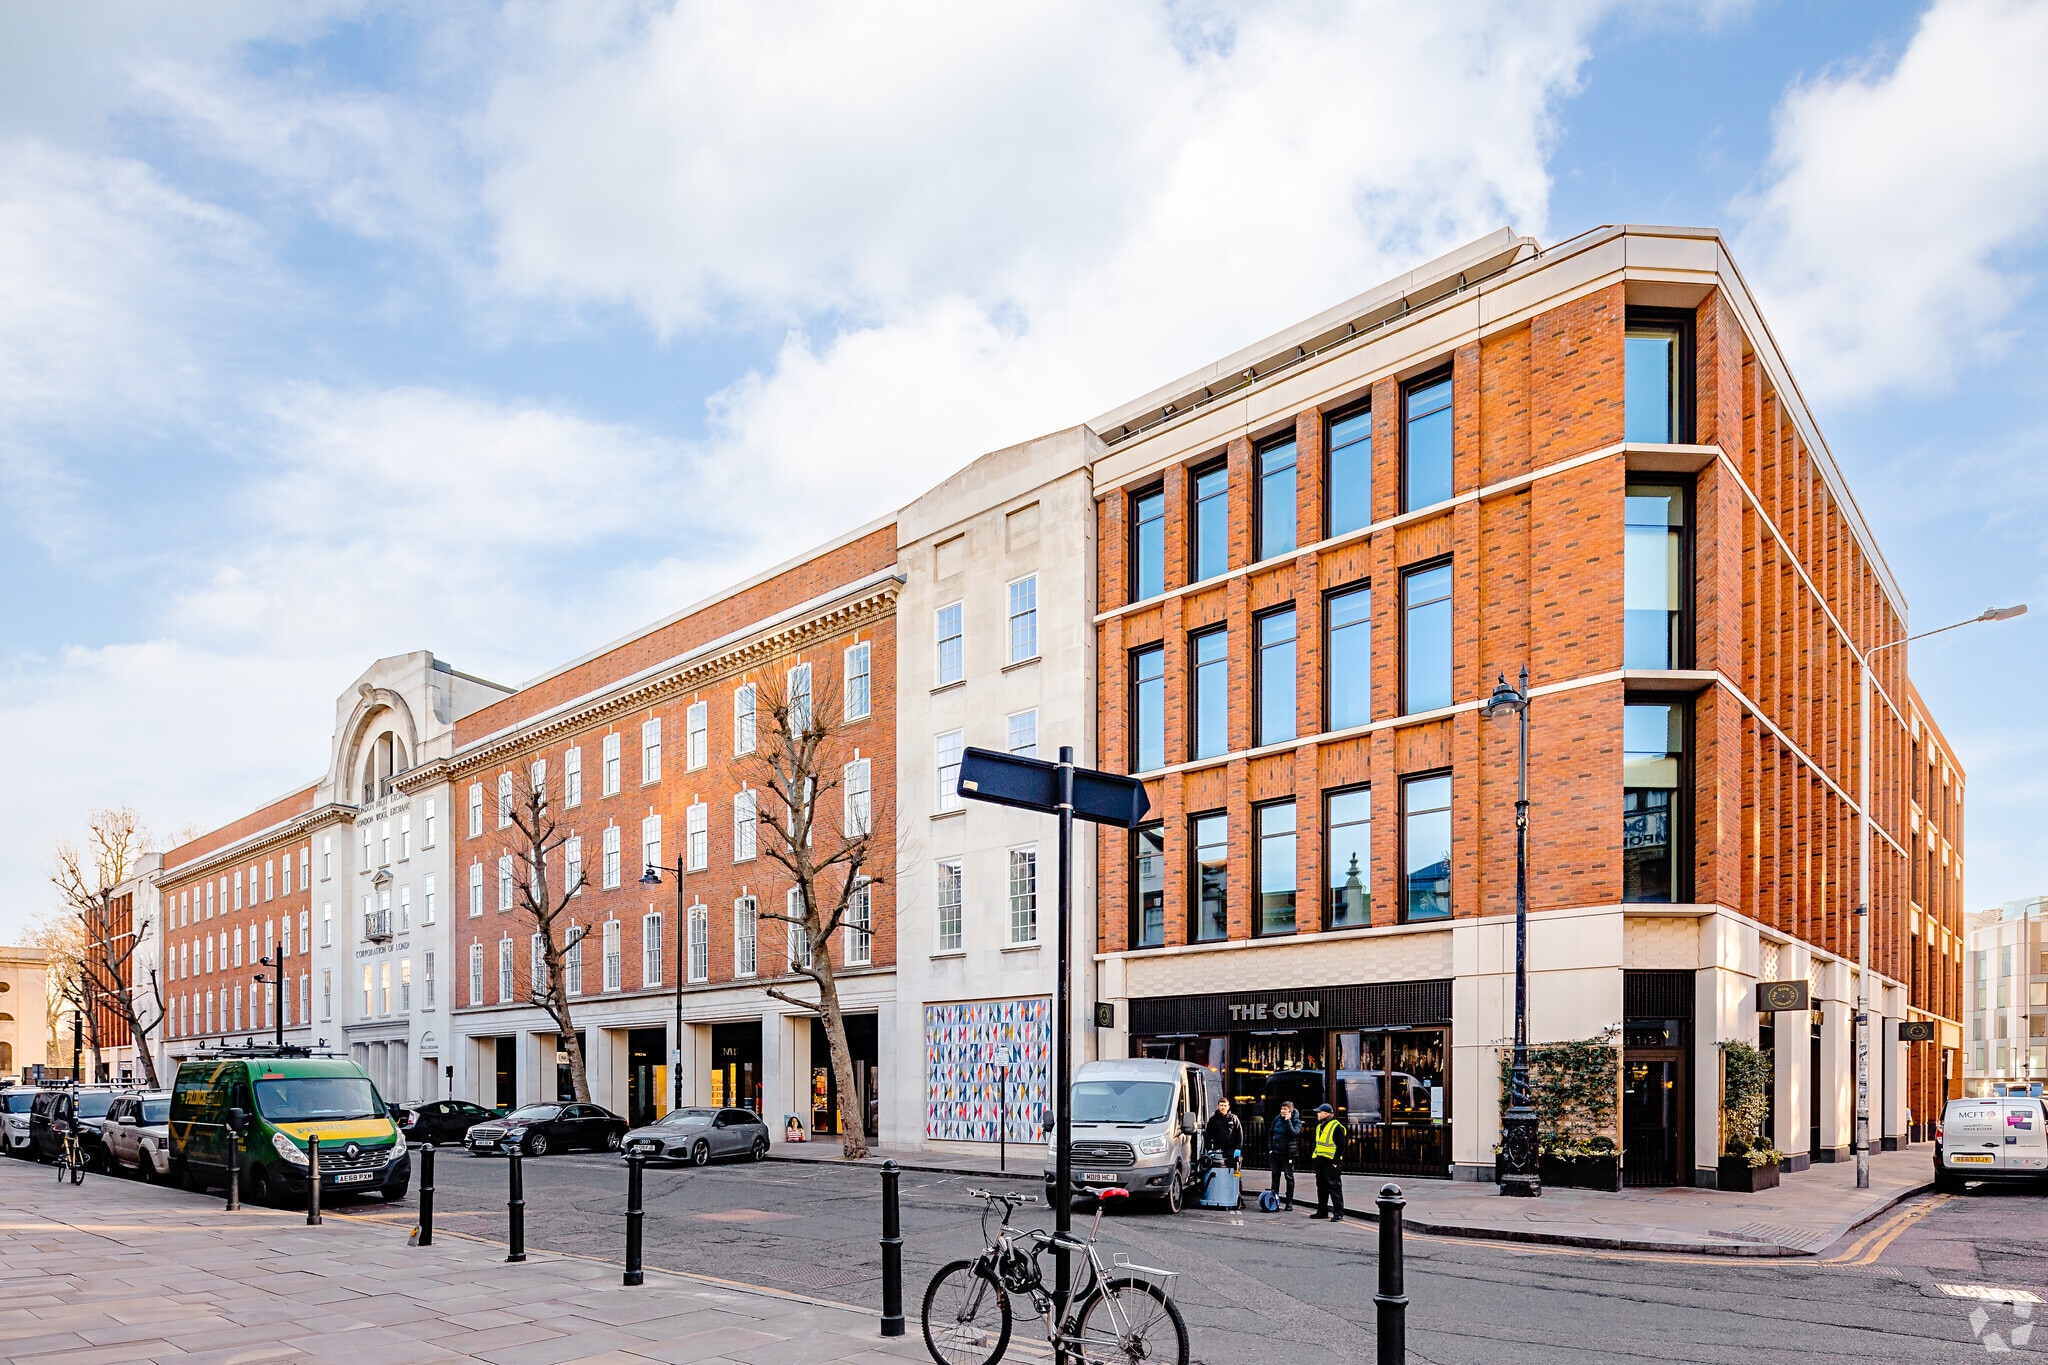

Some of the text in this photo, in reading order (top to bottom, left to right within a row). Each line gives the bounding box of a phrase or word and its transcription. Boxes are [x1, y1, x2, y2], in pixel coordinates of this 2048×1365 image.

[355, 947, 387, 959] CORPORATION
[388, 944, 394, 952] OF
[1228, 1000, 1319, 1021] THE GUN
[359, 1173, 372, 1181] PXM
